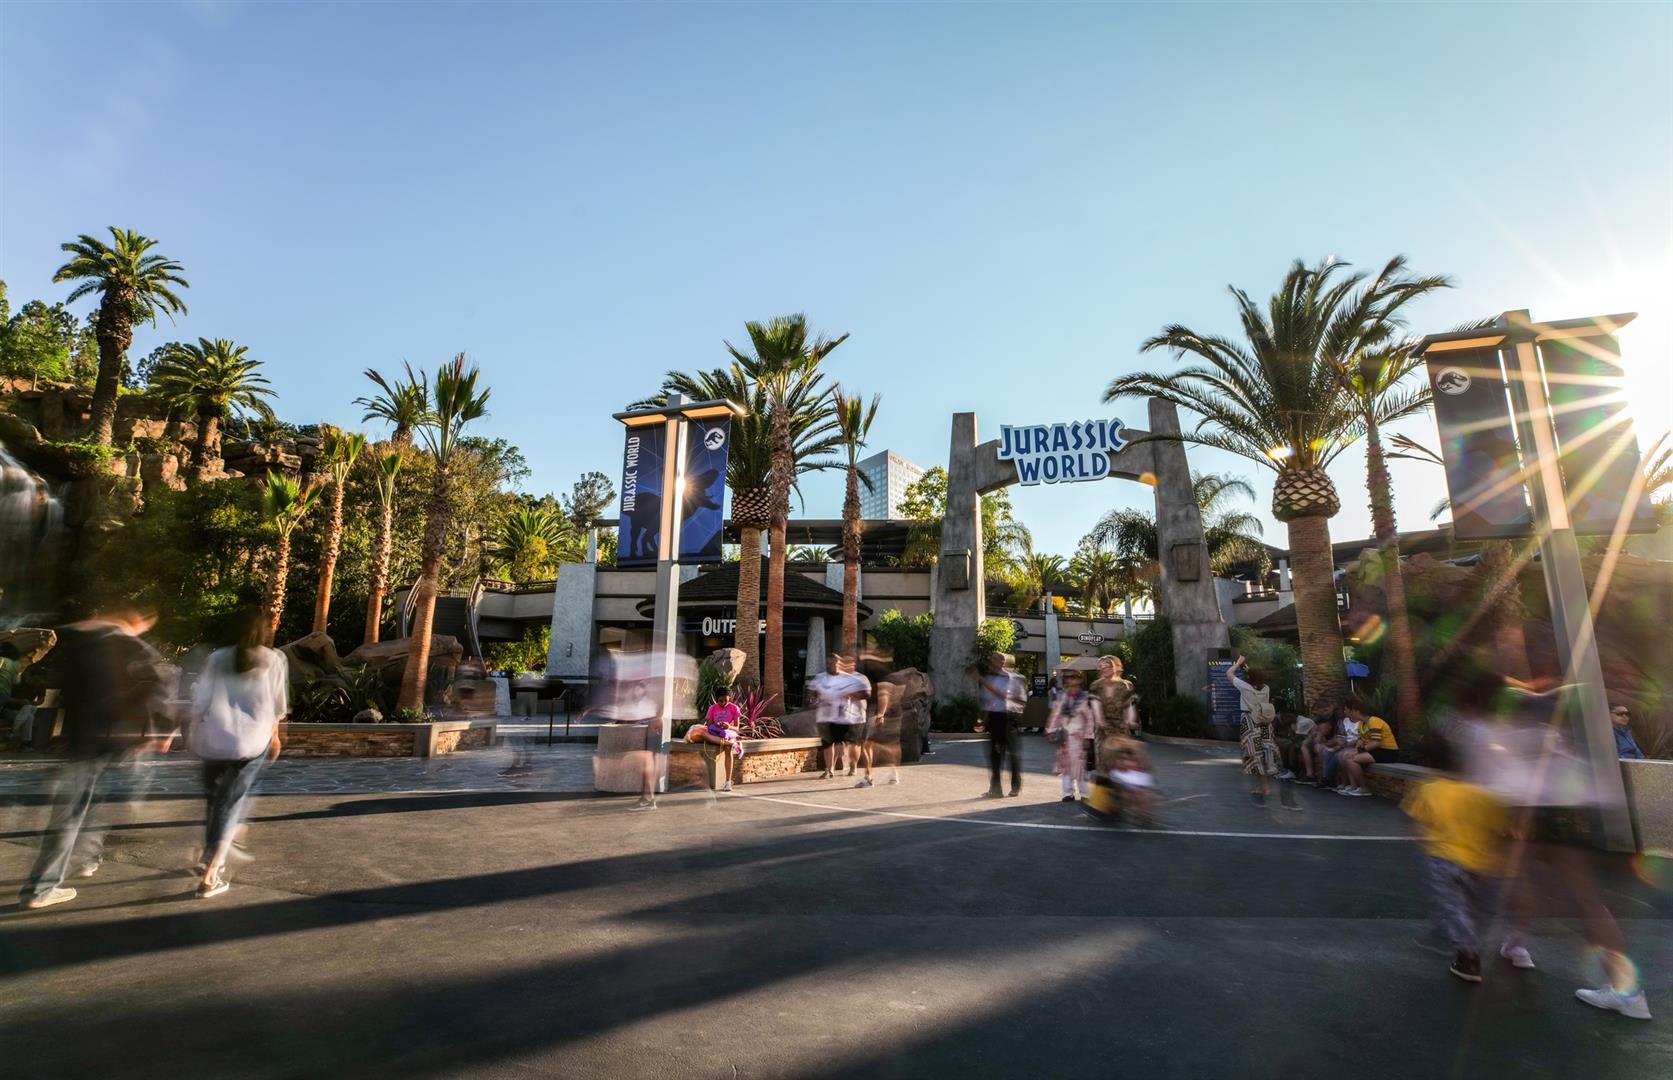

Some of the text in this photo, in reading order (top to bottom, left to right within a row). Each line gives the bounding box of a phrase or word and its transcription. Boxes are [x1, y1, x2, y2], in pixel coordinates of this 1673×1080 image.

[1001, 420, 1125, 456] JURASSIC
[623, 436, 640, 512] JURASSIC WORLD
[1018, 452, 1107, 481] WORLD
